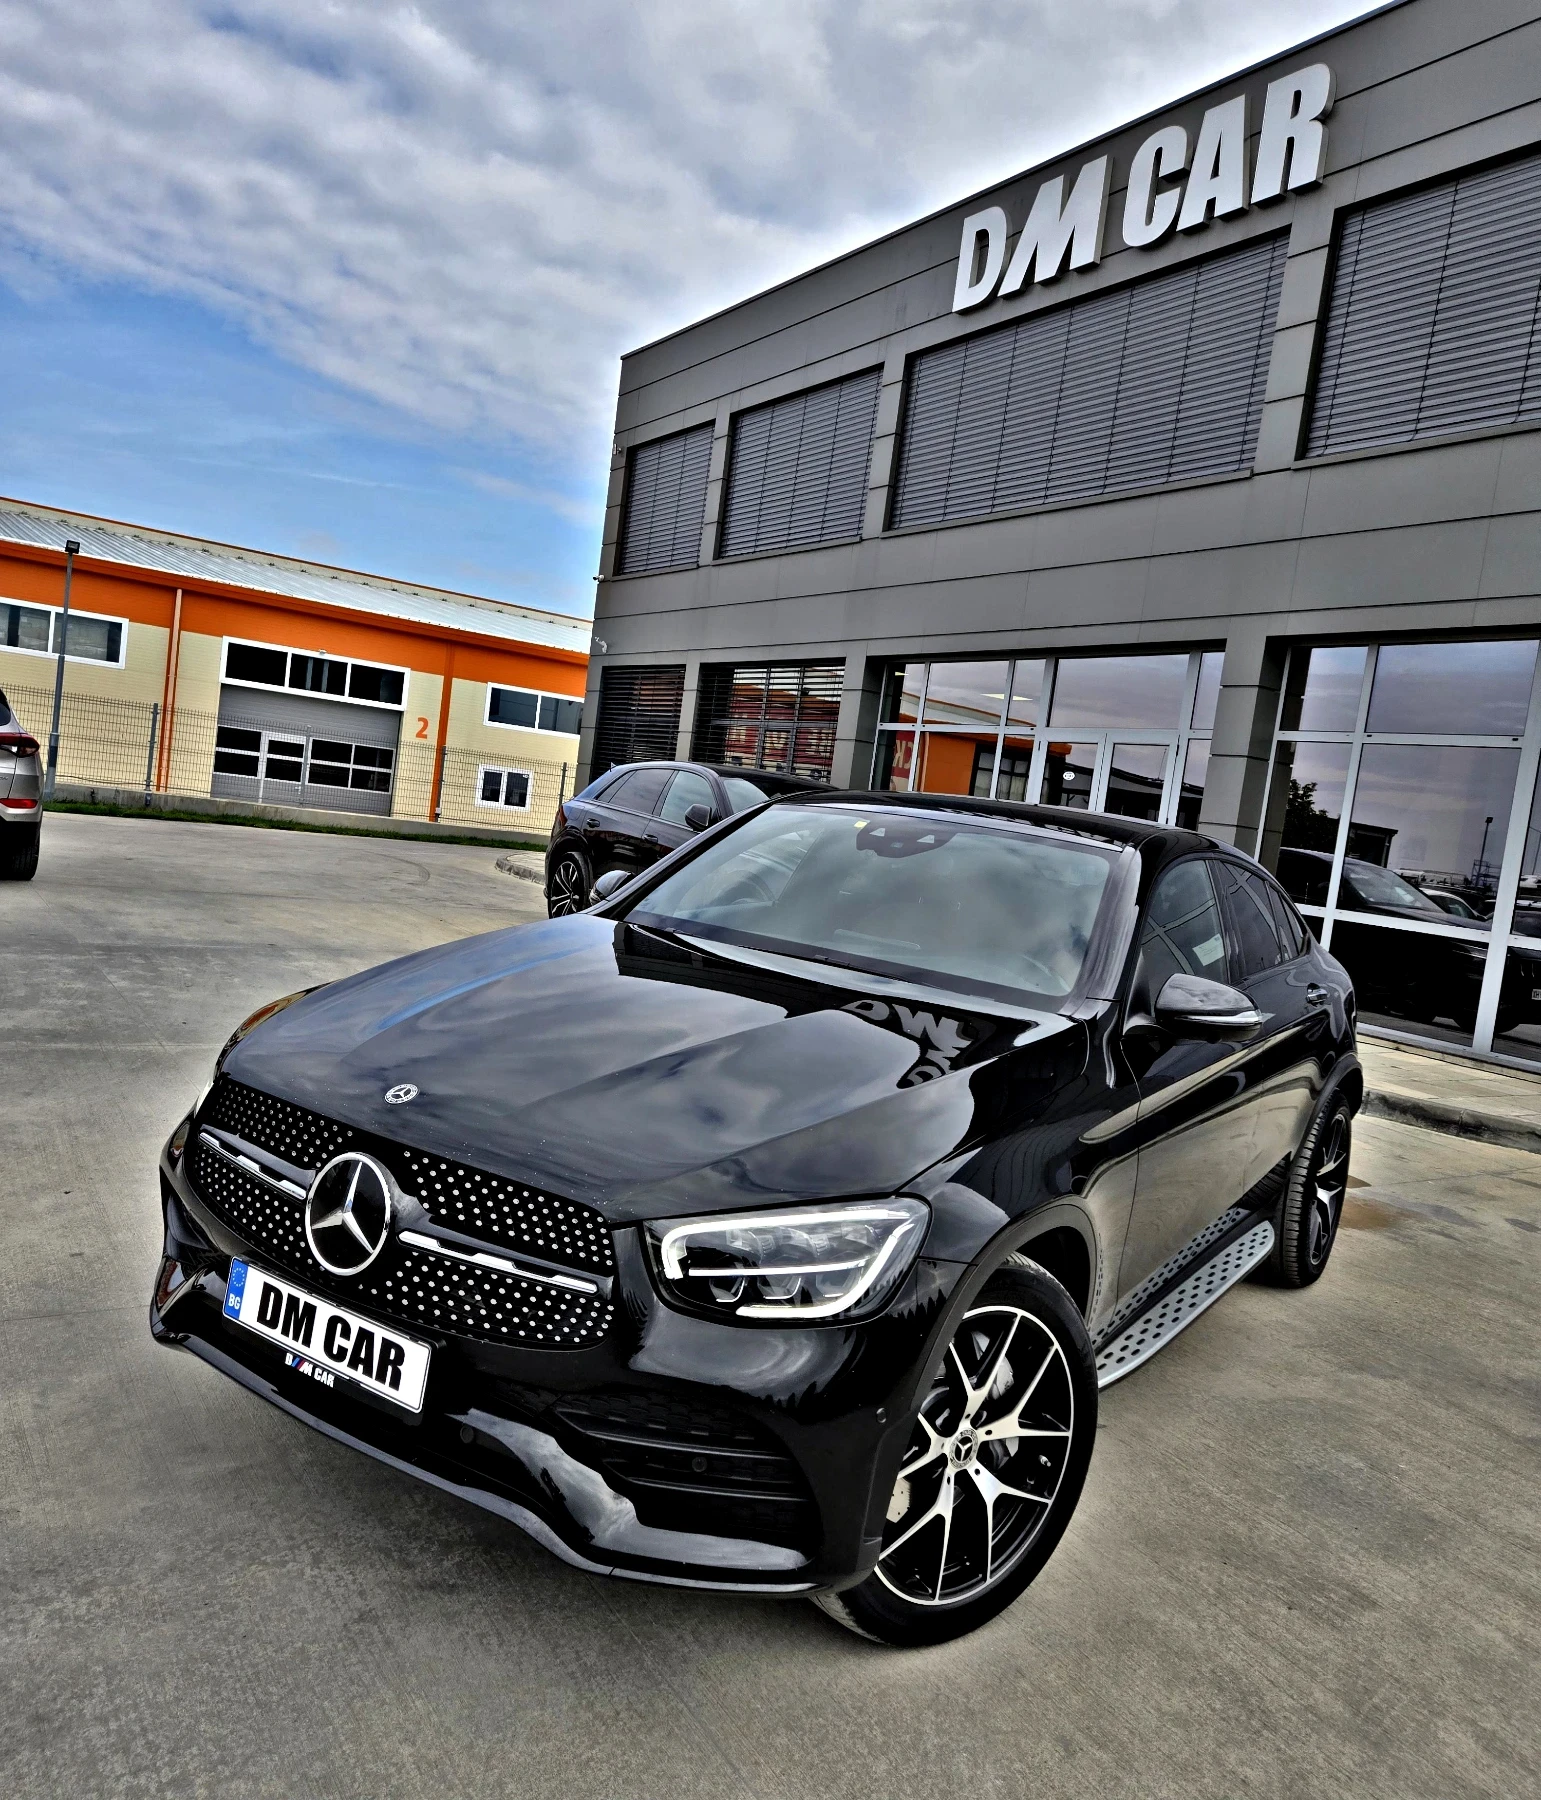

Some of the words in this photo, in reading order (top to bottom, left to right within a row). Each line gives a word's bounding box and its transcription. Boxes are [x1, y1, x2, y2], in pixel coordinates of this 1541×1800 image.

[952, 155, 1113, 315] DM
[1123, 62, 1337, 247] CAR
[416, 717, 429, 739] 2
[228, 1293, 241, 1310] BG
[256, 1281, 317, 1349] DM
[323, 1314, 406, 1392] CAR
[314, 1367, 335, 1388] CAR
